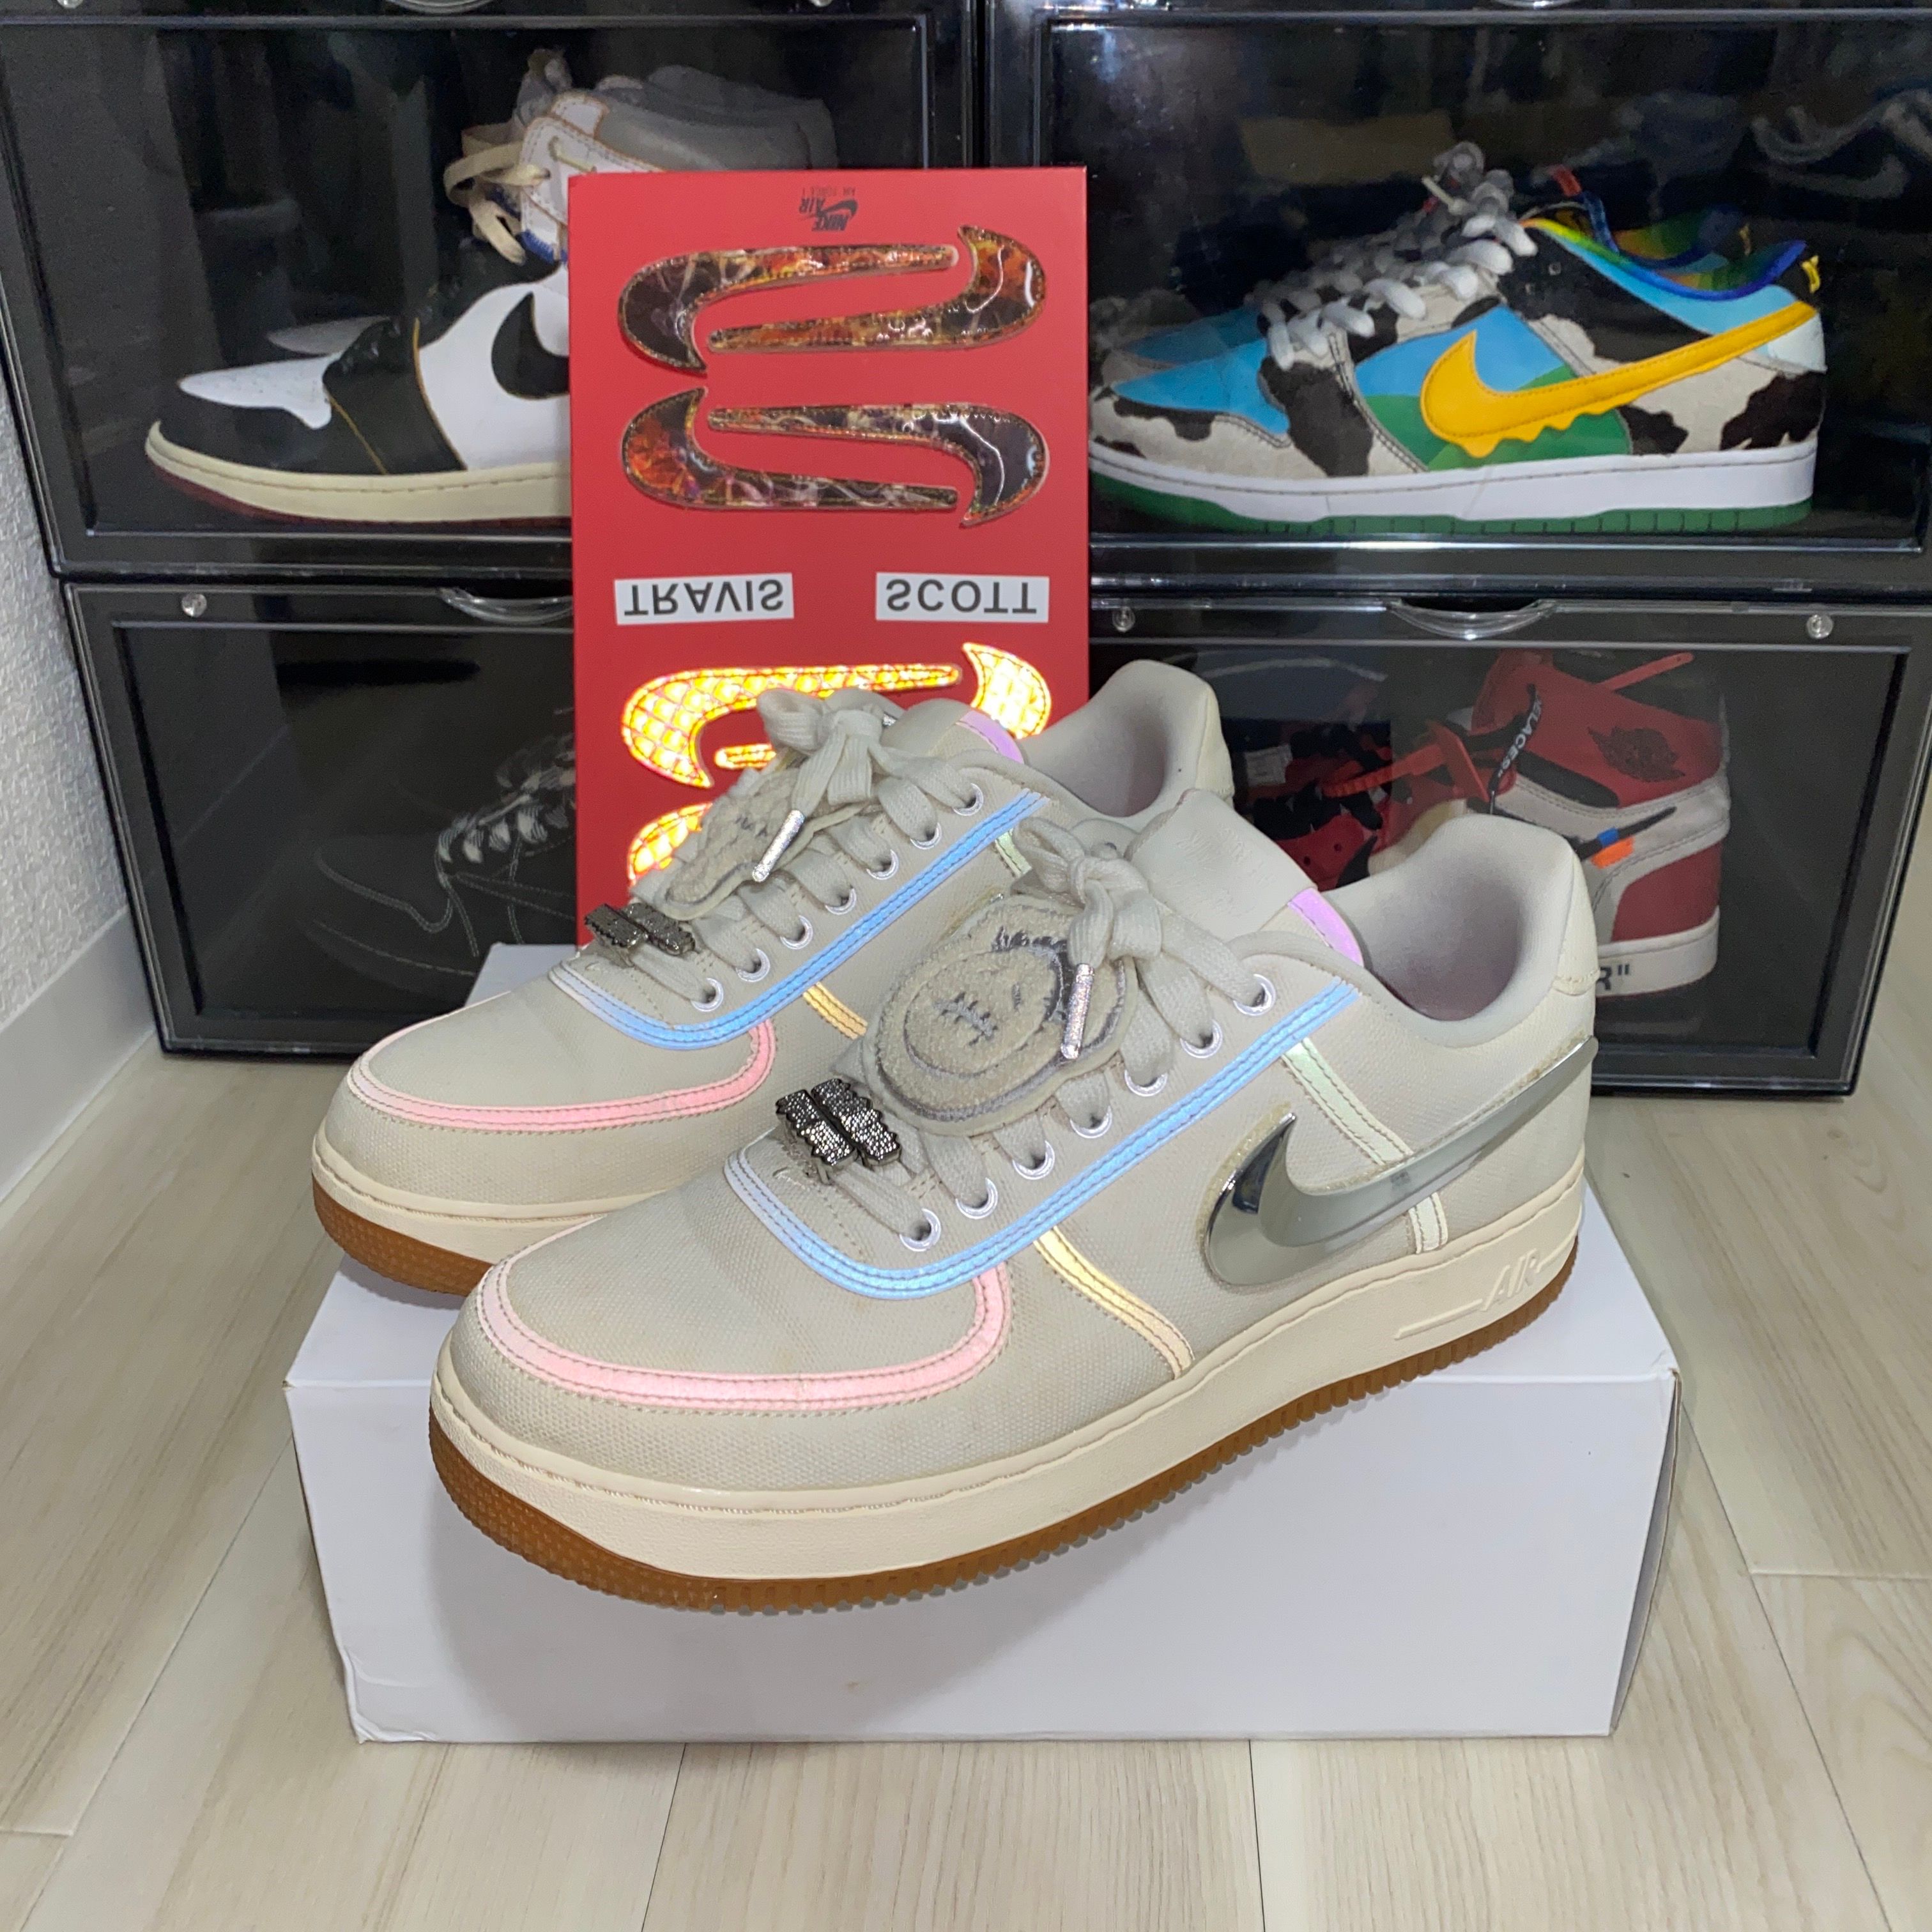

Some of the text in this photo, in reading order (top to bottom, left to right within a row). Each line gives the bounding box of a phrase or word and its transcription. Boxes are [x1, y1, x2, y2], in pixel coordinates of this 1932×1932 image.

[799, 197, 825, 214] AIR
[811, 214, 848, 231] NIKE
[1481, 1248, 1540, 1312] AIR
